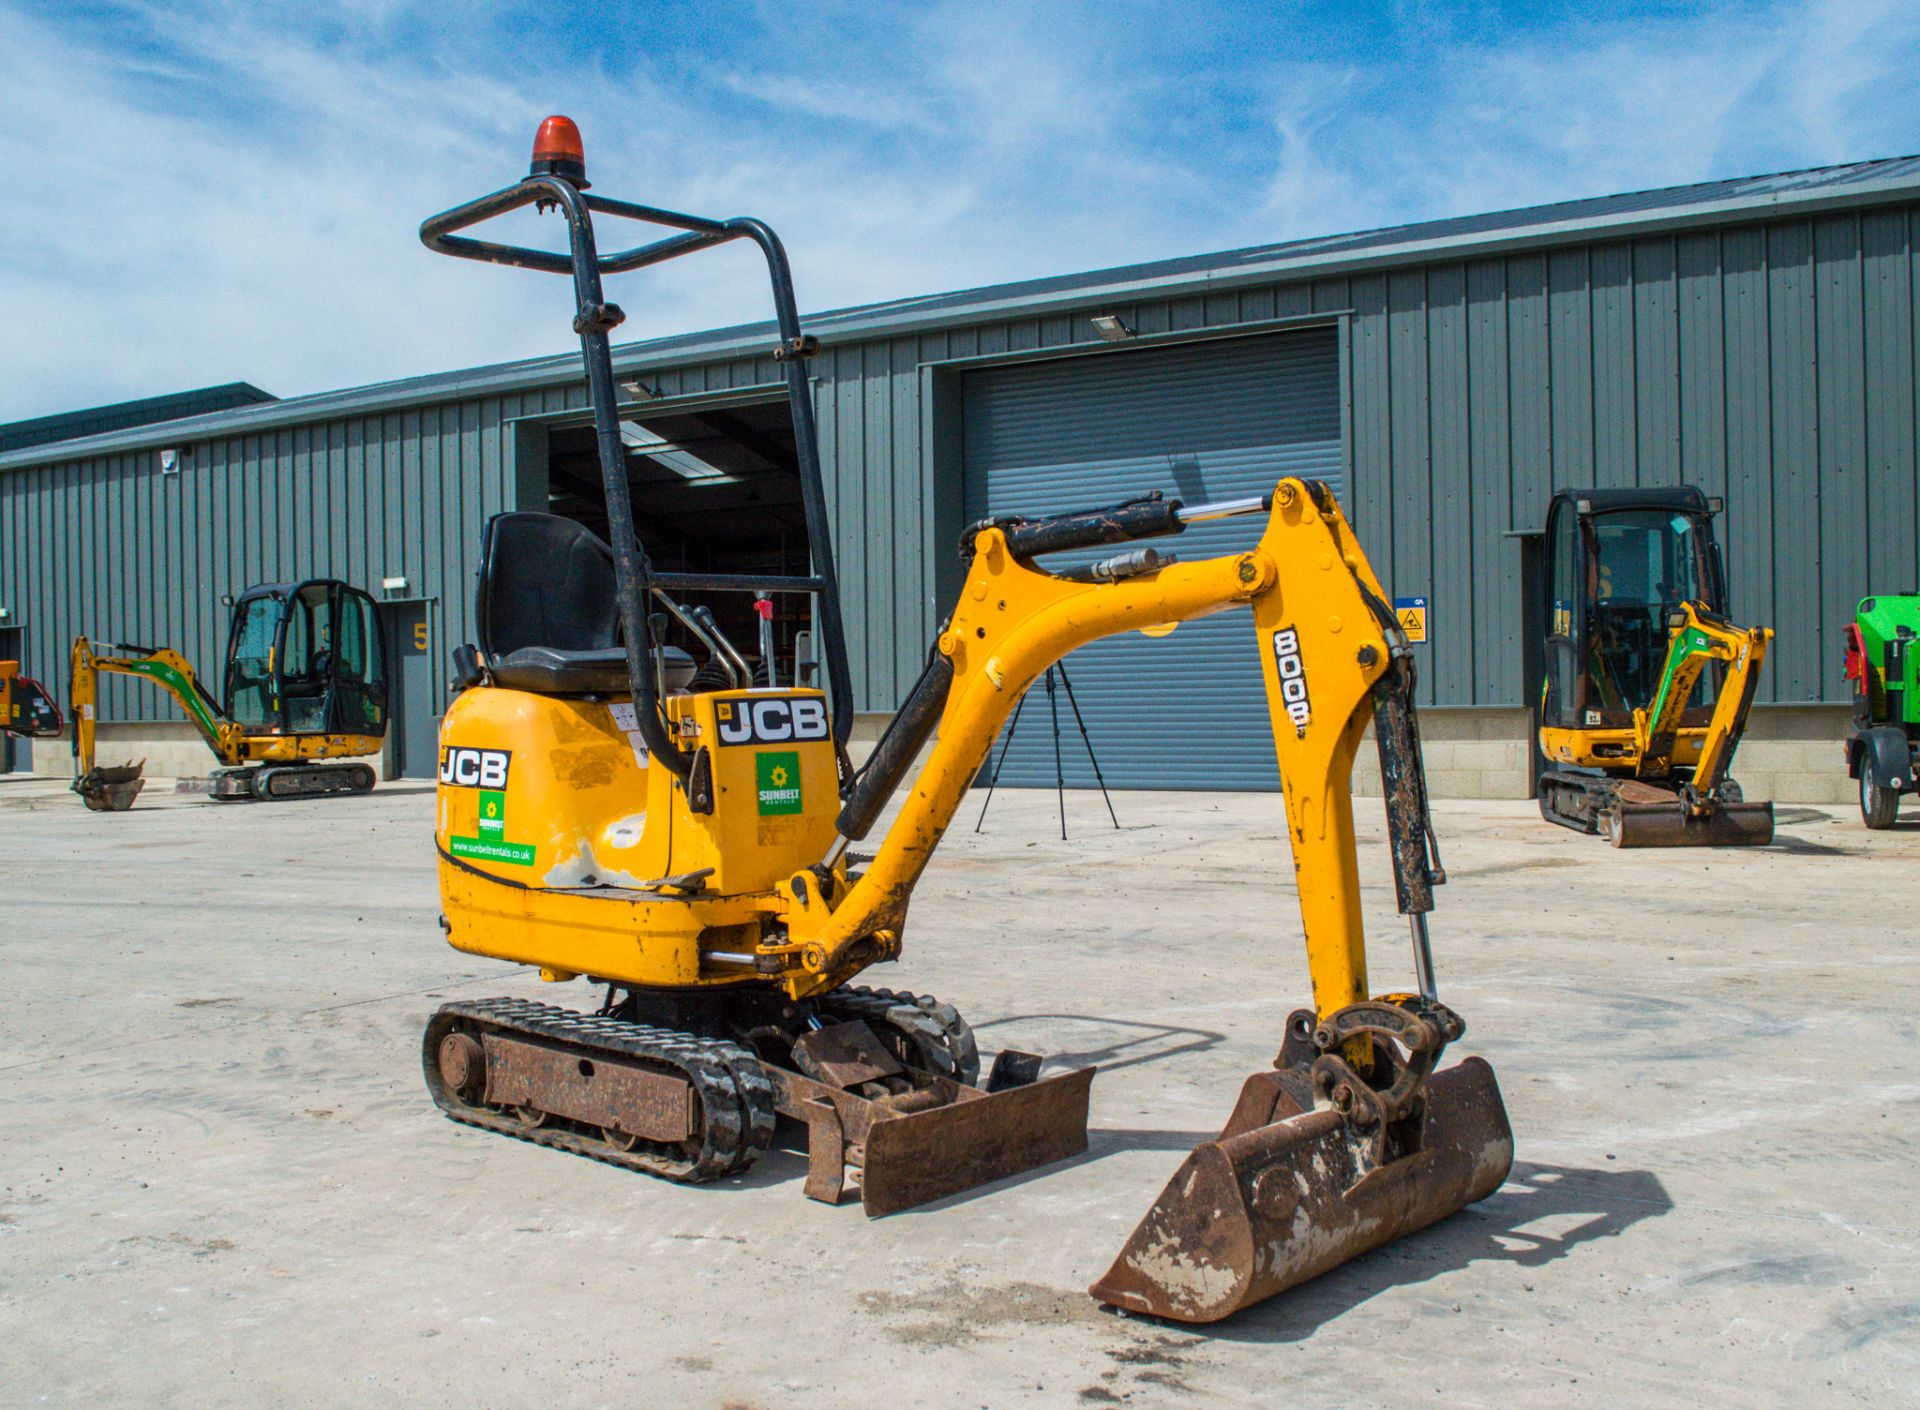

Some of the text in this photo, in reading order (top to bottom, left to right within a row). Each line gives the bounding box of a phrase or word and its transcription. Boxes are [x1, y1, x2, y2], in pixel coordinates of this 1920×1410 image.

[414, 623, 428, 650] 5
[1274, 630, 1309, 727] 8008
[720, 700, 828, 743] JCB
[440, 749, 508, 788] JCB
[759, 789, 800, 801] SUNBELT
[452, 842, 530, 860] www.sunbeltrentals.co.uk
